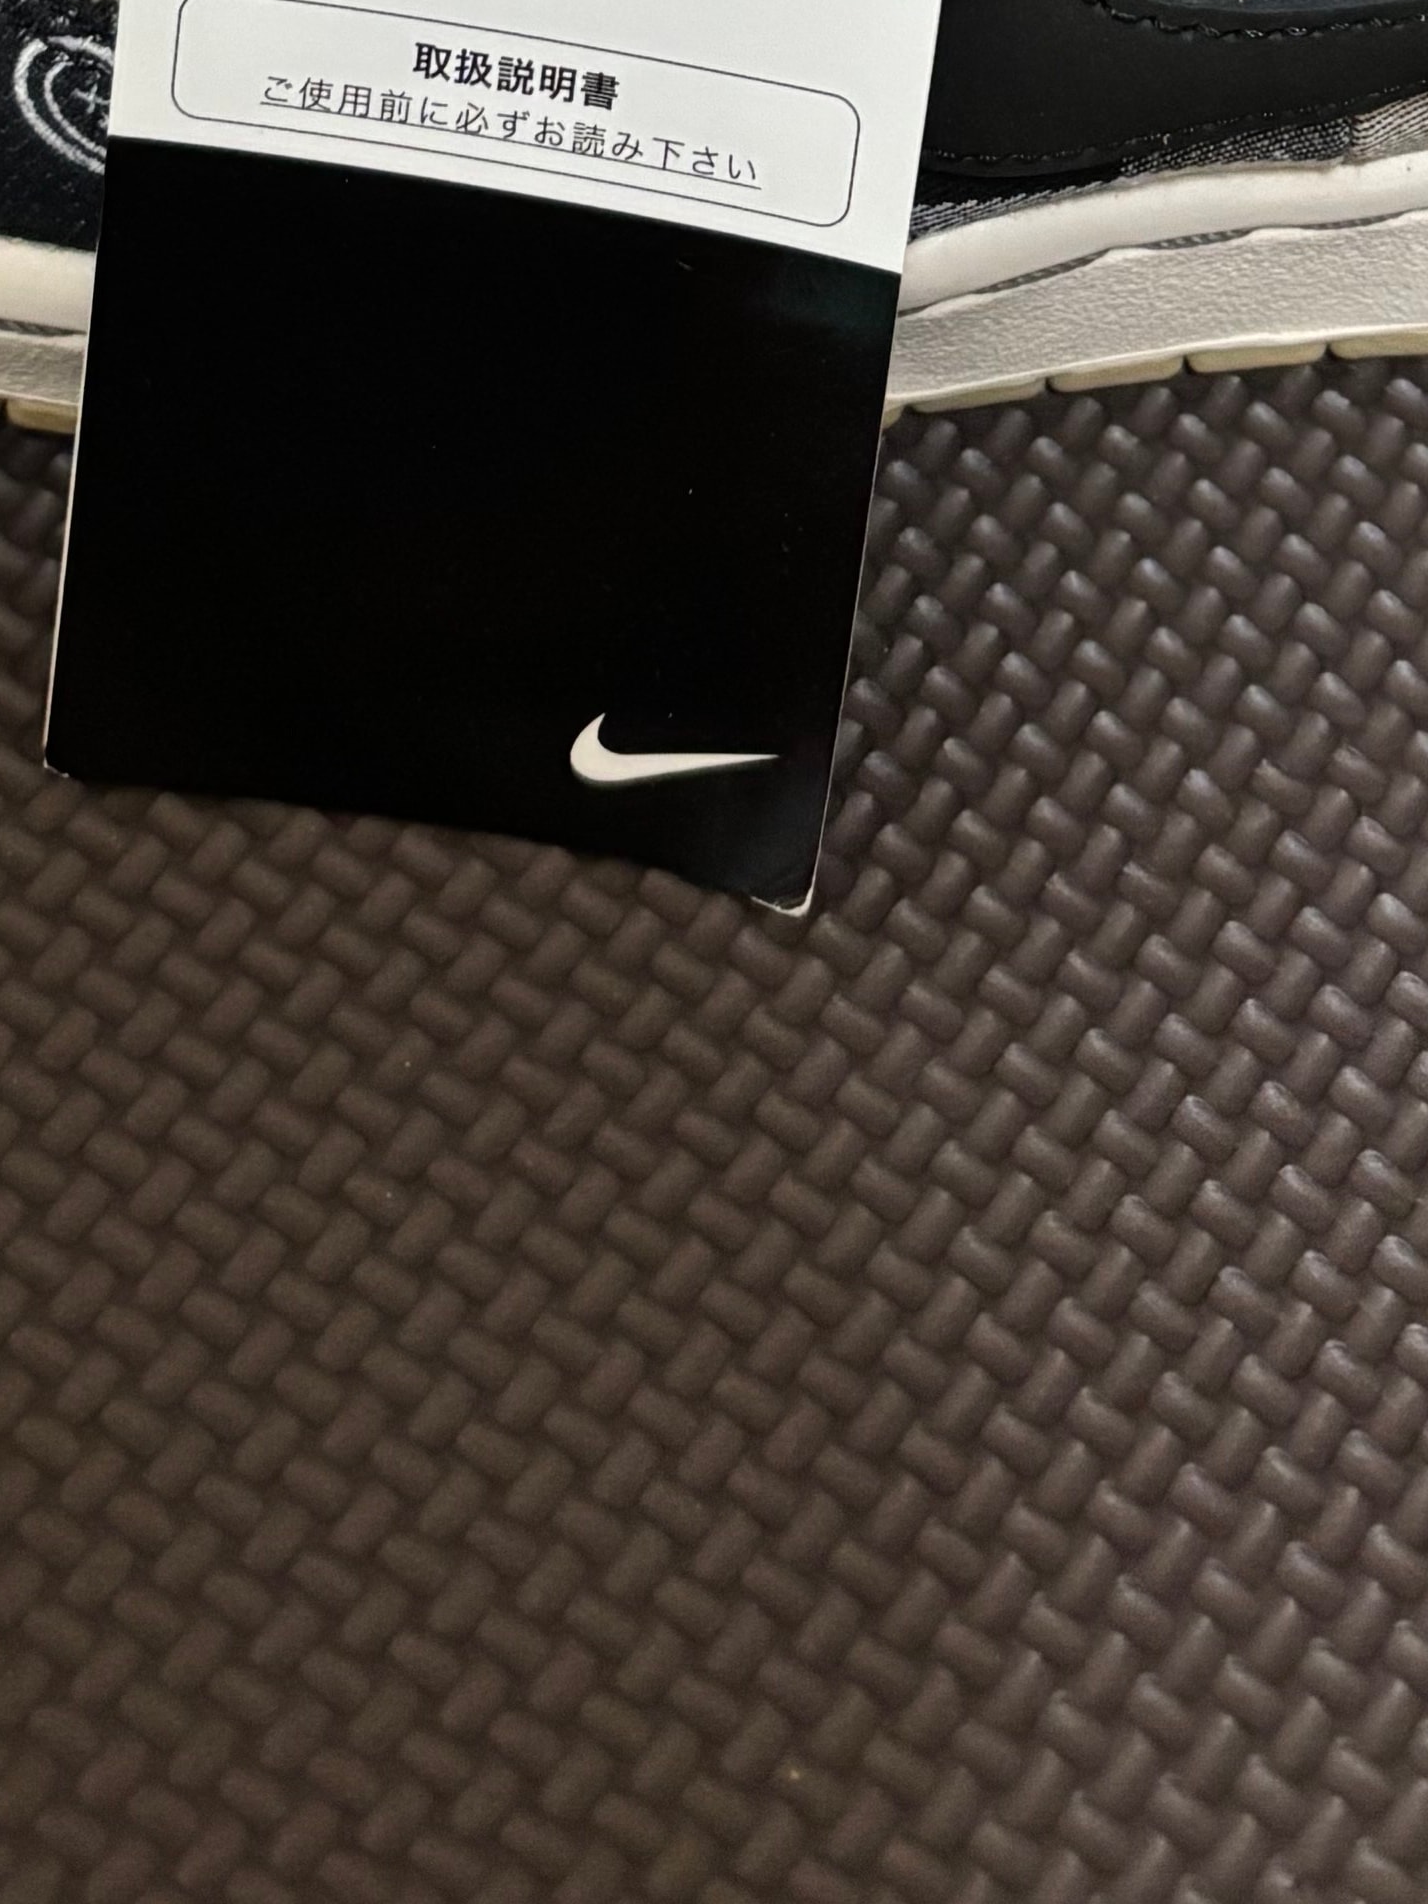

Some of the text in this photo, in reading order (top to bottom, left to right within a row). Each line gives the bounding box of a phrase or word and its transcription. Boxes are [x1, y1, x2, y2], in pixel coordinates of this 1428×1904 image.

[412, 41, 620, 111] 取扱説明書
[262, 75, 758, 181] ご使用前に必ずお読み下さい
